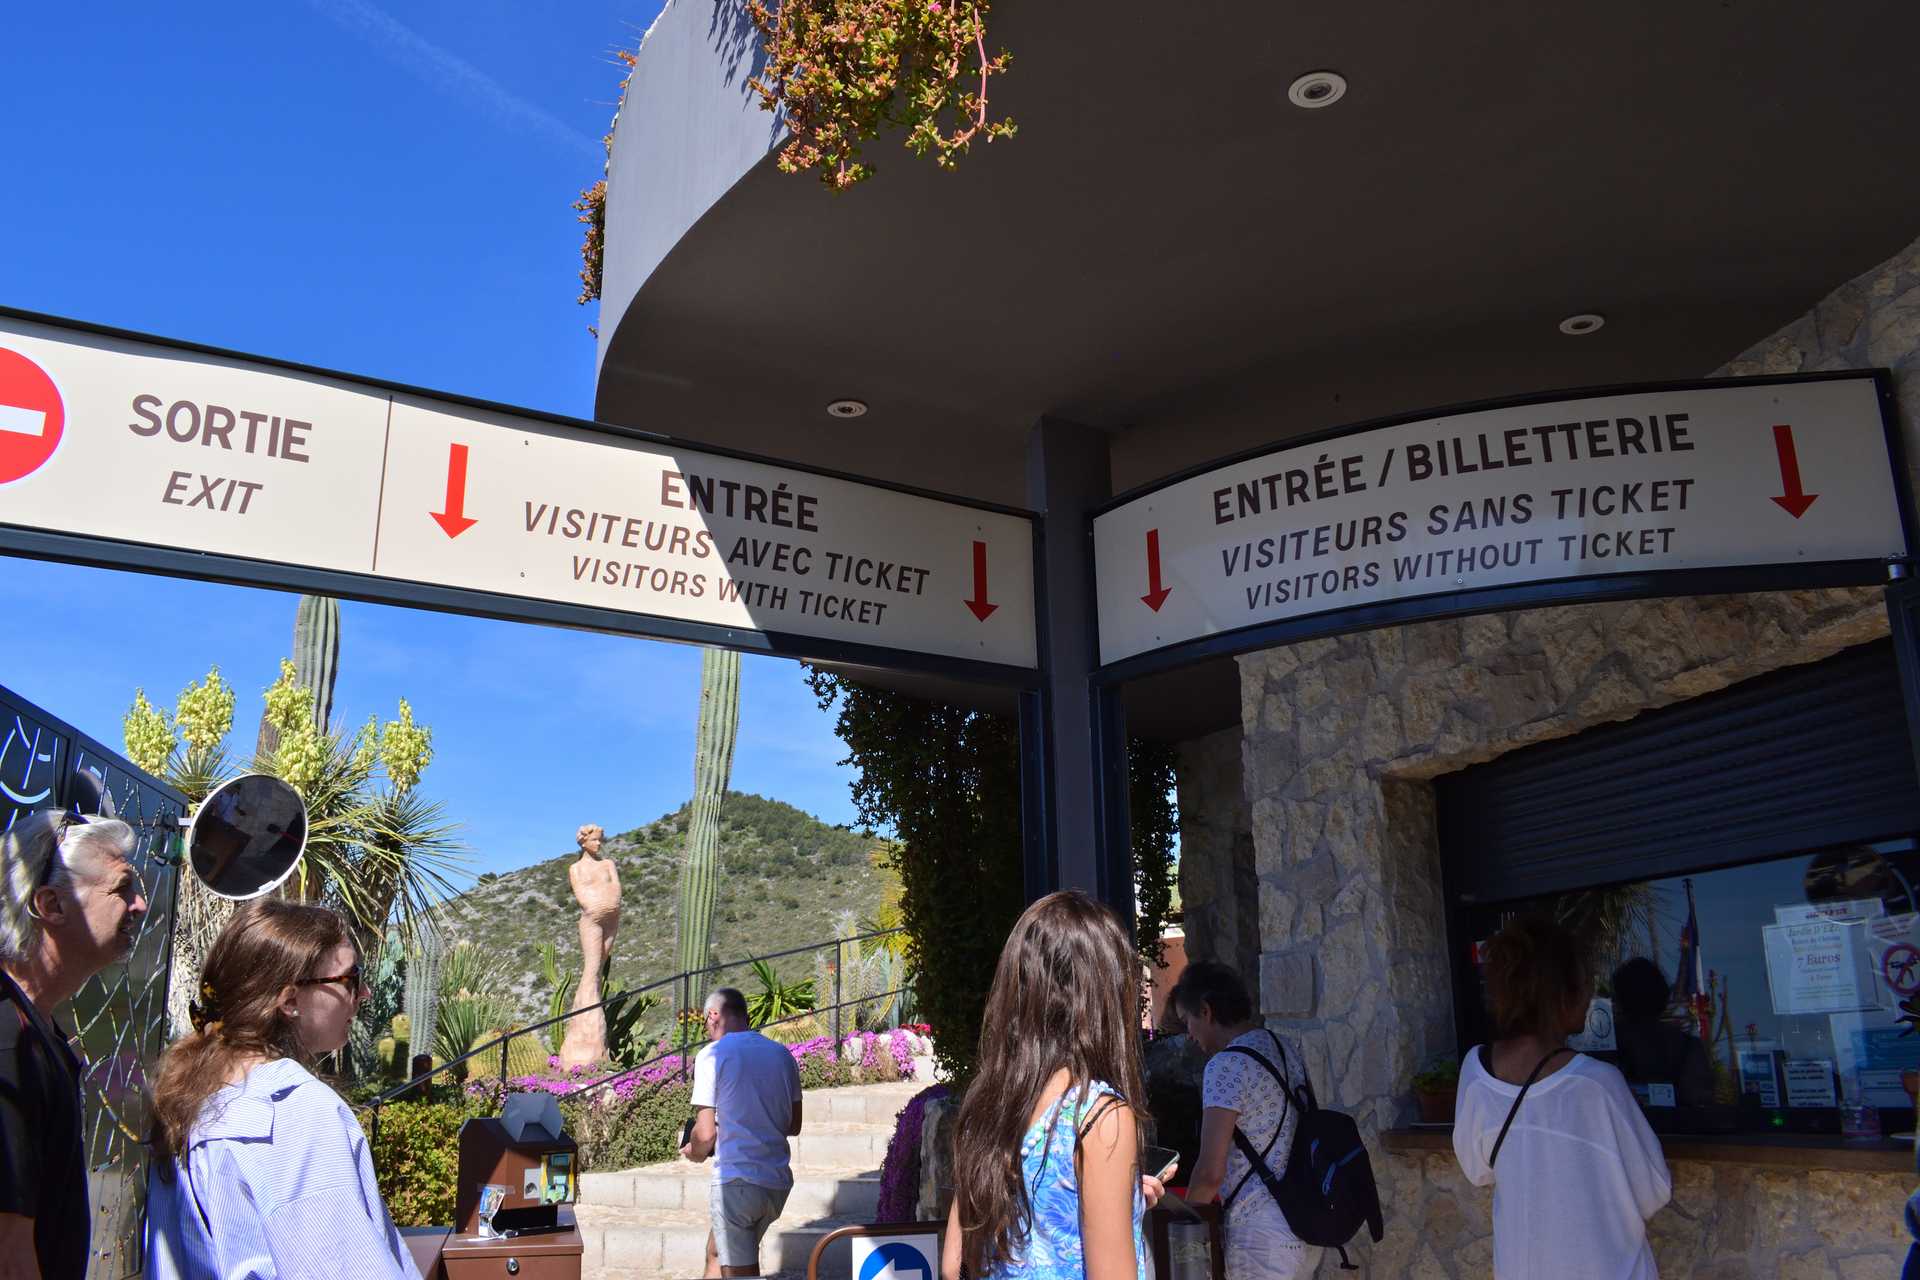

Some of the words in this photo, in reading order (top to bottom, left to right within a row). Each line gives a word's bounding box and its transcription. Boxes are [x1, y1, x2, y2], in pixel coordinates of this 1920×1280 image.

[129, 393, 312, 463] SORTIE
[162, 470, 263, 515] EXIT
[661, 470, 818, 532] ENTRÉE
[1213, 454, 1367, 525] ENTRÉE
[1406, 413, 1694, 481] BILLETTERIE
[524, 501, 713, 559] VISITEURS
[728, 536, 812, 575] AVEC
[825, 551, 930, 596] TICKET
[1222, 511, 1409, 577] VISITEURS
[1427, 493, 1533, 536] SANS
[1551, 478, 1694, 520] TICKET
[572, 555, 707, 599] VISITORS
[717, 578, 788, 610] WITH
[800, 590, 888, 626] TICKET
[1246, 562, 1380, 610] VISITORS
[1393, 539, 1543, 583] WITHOUT
[1558, 528, 1676, 562] TICKET
